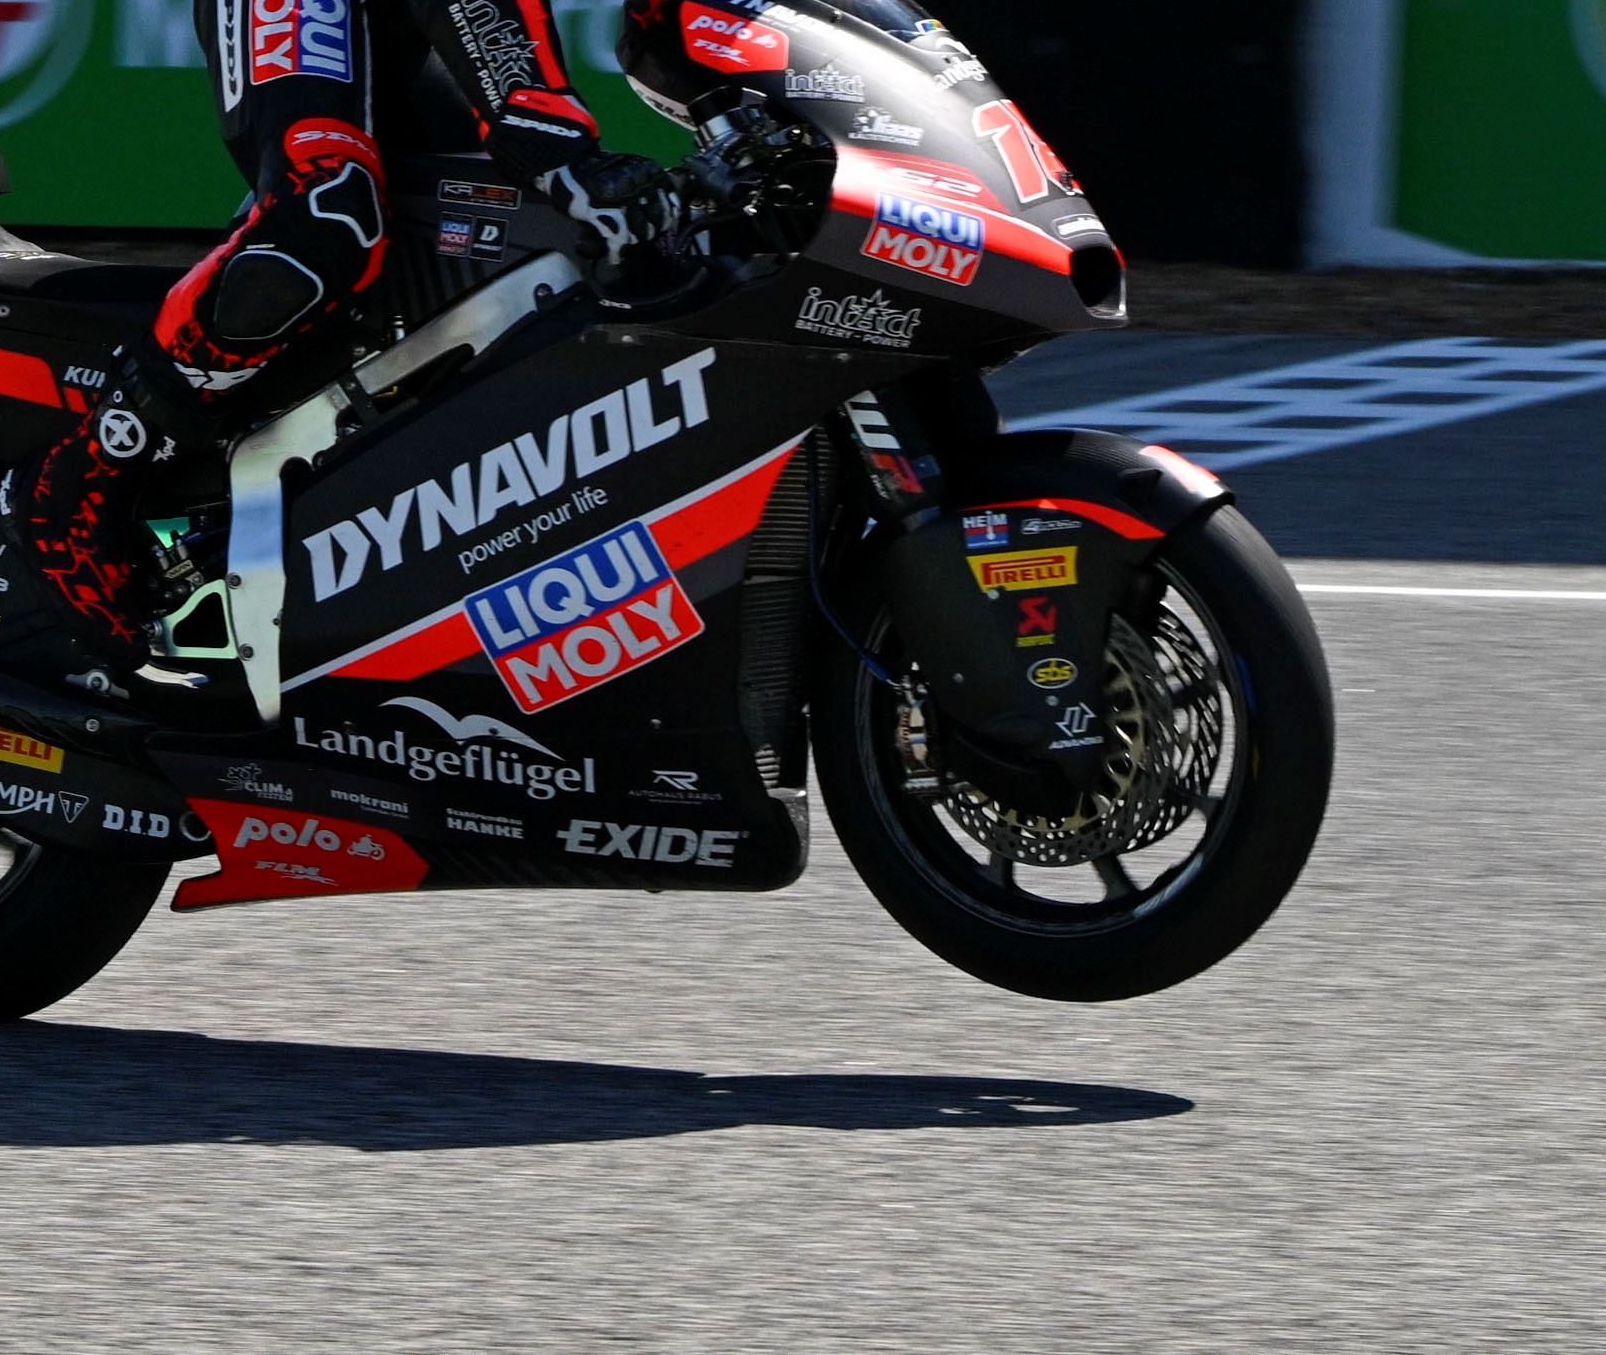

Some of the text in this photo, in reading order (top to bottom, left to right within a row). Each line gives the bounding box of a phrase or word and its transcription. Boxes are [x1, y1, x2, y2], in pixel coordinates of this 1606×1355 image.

[447, 2, 479, 60] BATTERY
[686, 14, 754, 40] polo
[879, 196, 982, 247] LIQUI
[867, 228, 979, 280] MOLY
[794, 319, 852, 340] BATTERY
[861, 331, 913, 349] POWER
[301, 346, 717, 602] DYNAVOLT
[457, 483, 609, 575] power your life
[486, 533, 662, 650] LIQUI
[980, 554, 1068, 586] PIRELLI
[505, 585, 686, 706] MOLY
[1034, 659, 1074, 684] sbs
[293, 716, 596, 800] Landgeflügel
[101, 804, 171, 839] D.I.D
[329, 788, 410, 814] mokrani
[232, 816, 342, 852] polo
[446, 816, 525, 840] HANKE
[555, 818, 743, 868] EXIDE
